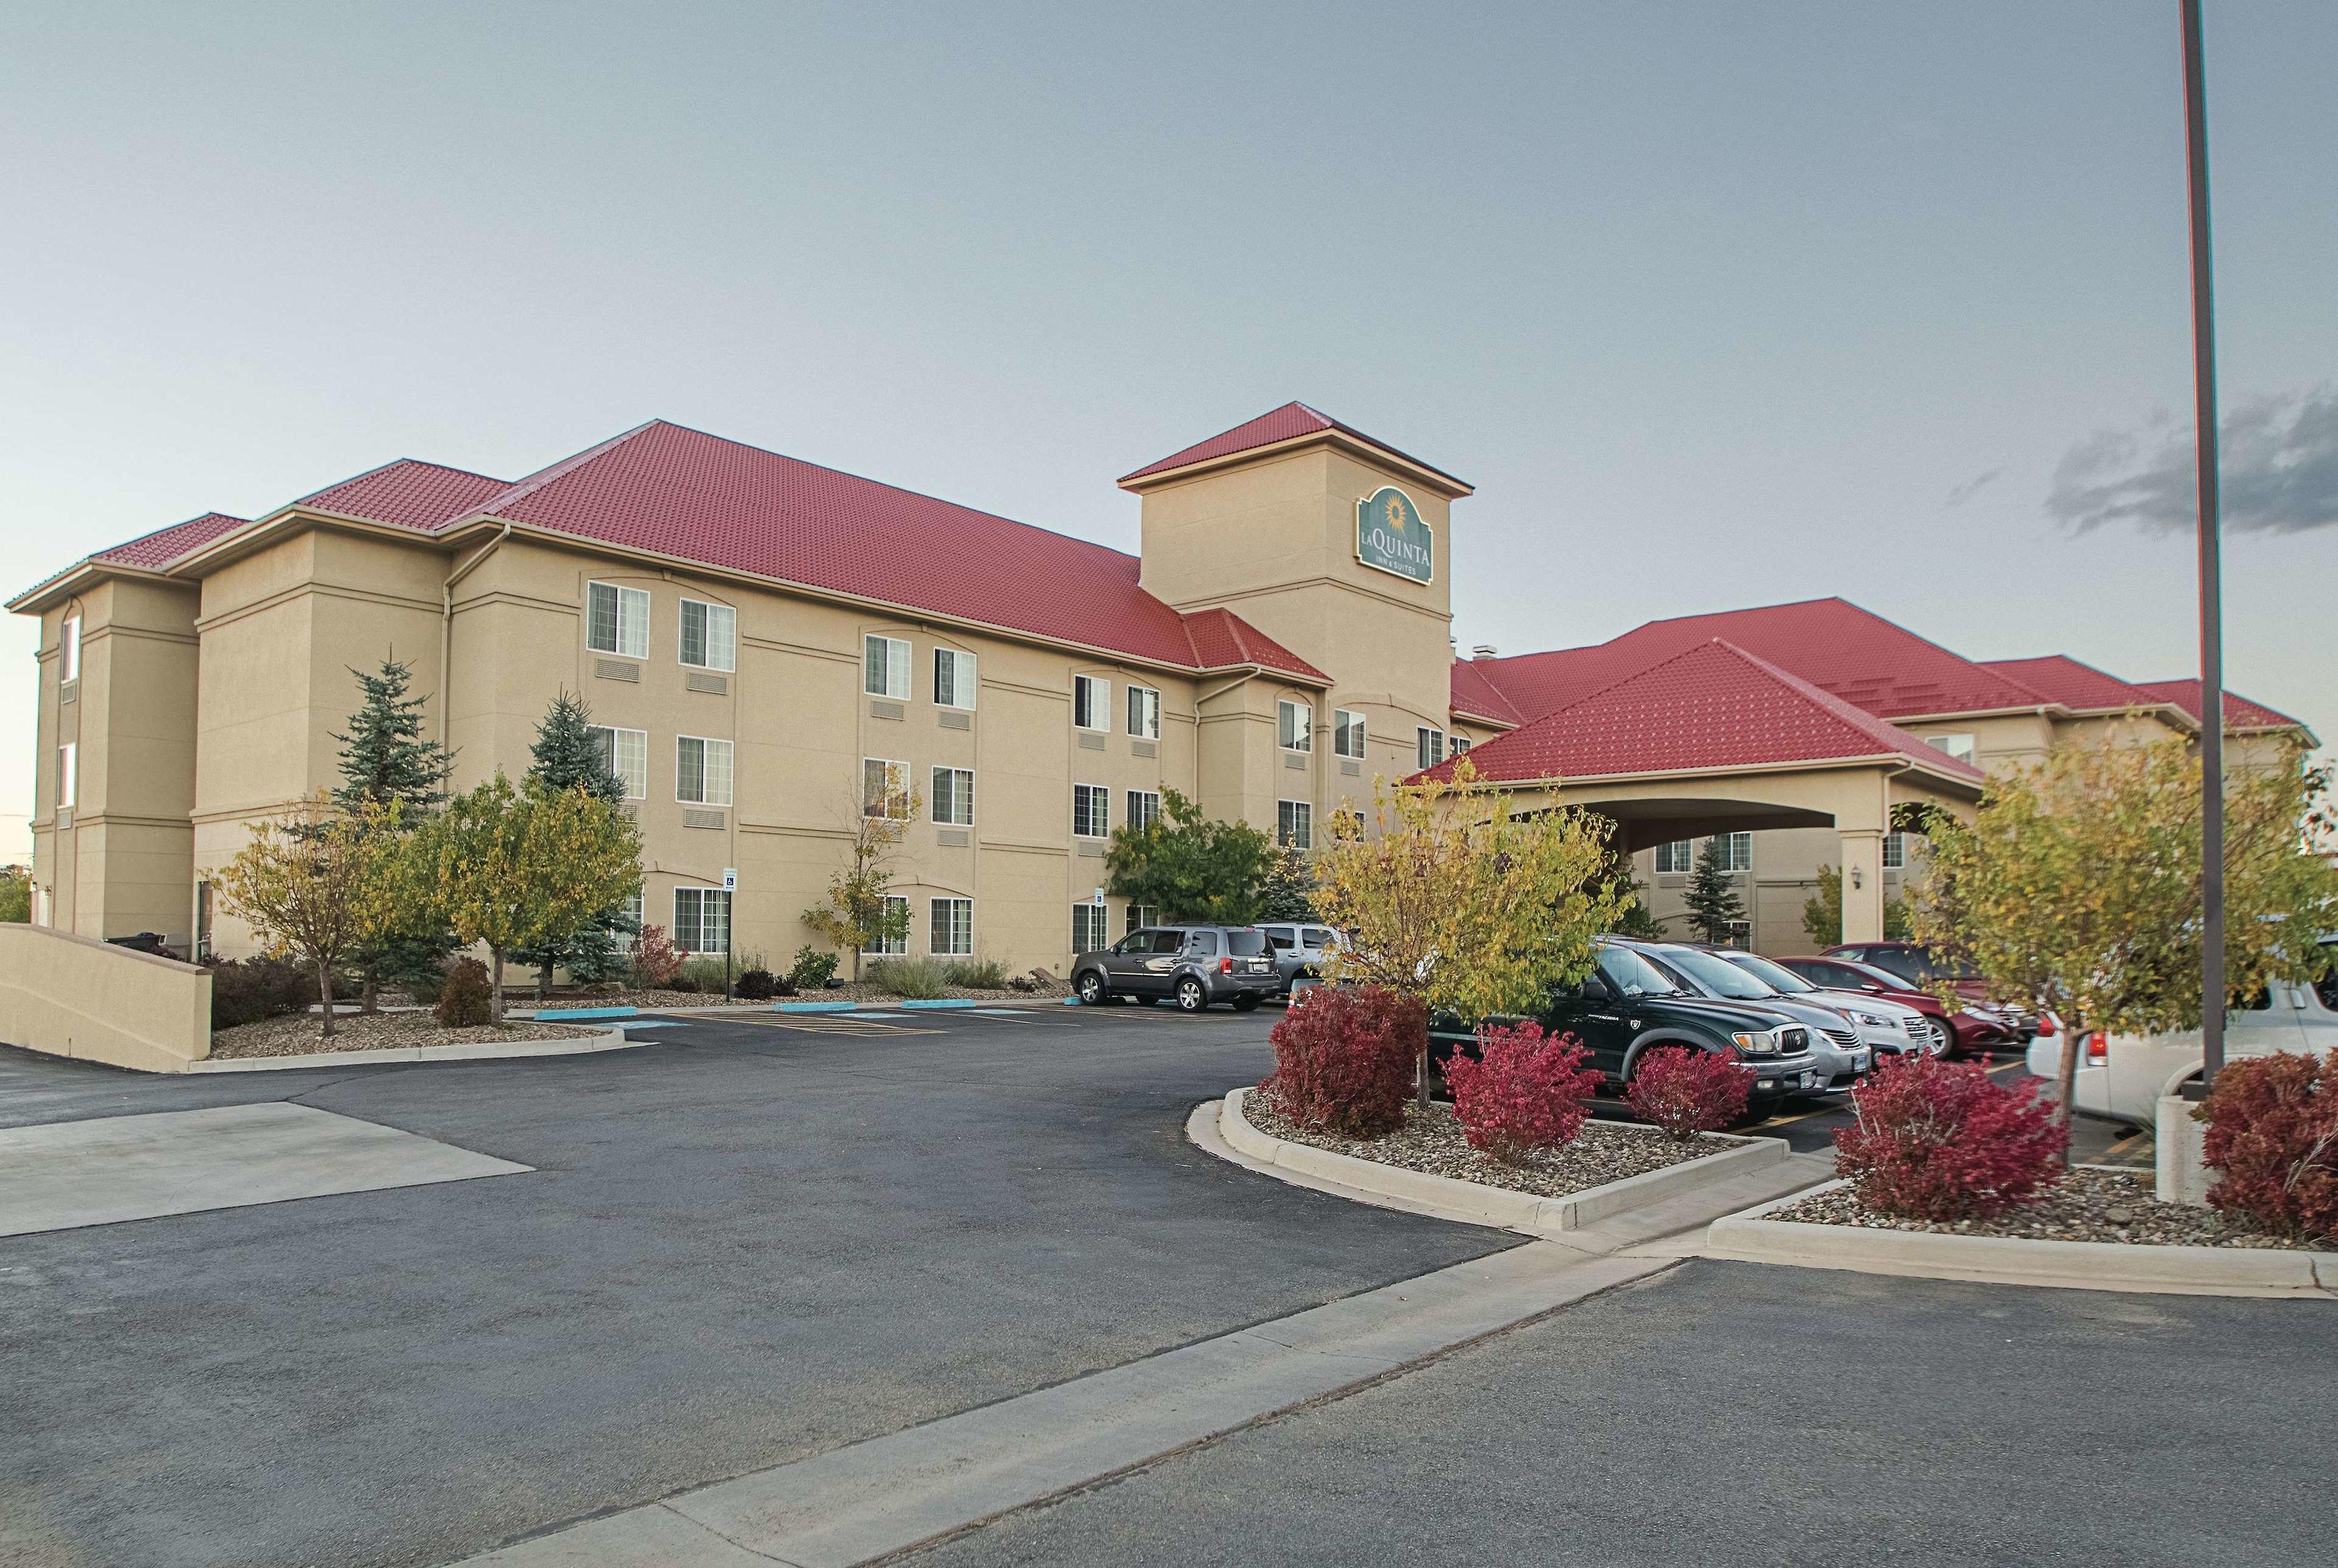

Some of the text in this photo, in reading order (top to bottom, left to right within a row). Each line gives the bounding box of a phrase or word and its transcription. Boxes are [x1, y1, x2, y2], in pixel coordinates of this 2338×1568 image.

[1361, 528, 1430, 566] LA QUINTA
[1376, 555, 1388, 565] INN
[1393, 561, 1417, 576] SUITES
